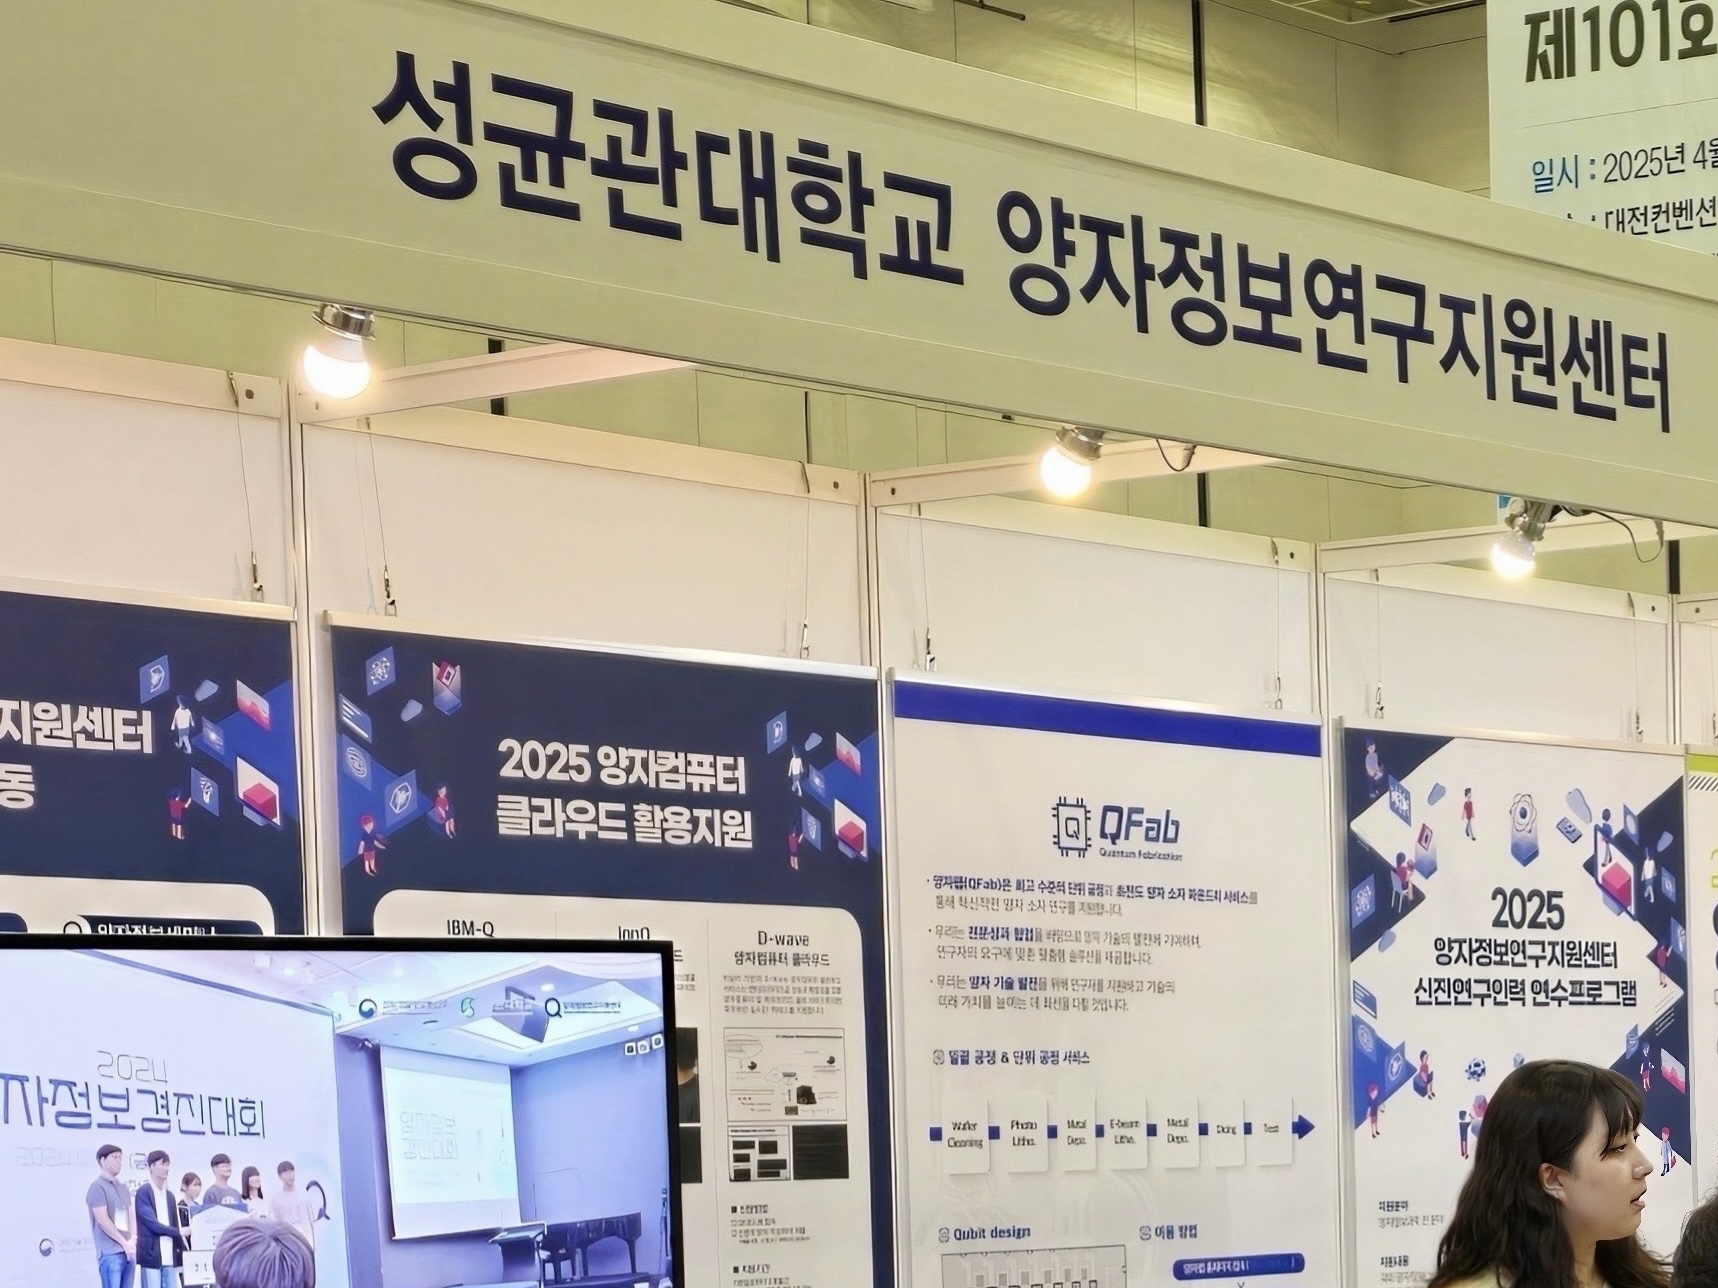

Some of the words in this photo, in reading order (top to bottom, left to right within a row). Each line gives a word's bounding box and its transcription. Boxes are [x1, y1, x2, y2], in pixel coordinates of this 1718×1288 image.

[1531, 154, 1580, 194] 일시
[1603, 142, 1686, 184] 2025년
[372, 50, 965, 286] 성균관대학교
[996, 190, 1671, 434] 양자정보연구지원센터
[0, 699, 153, 754] 지원센터
[498, 738, 592, 783] 2025
[596, 745, 747, 795] 양자컴퓨터
[496, 795, 628, 840] 클라우드
[632, 803, 753, 849] 활용지원
[1099, 804, 1181, 845] QFab
[446, 918, 495, 938] IBM-Q
[1491, 888, 1566, 931] 2025
[758, 930, 810, 947] D-wave
[1434, 937, 1618, 970] 양자정보연구지원센터
[1414, 977, 1526, 1009] 신진연구인력
[1530, 978, 1637, 1009] 연수프로그램
[0, 1072, 266, 1139] 자정보경진대회
[990, 1225, 1030, 1240] design
